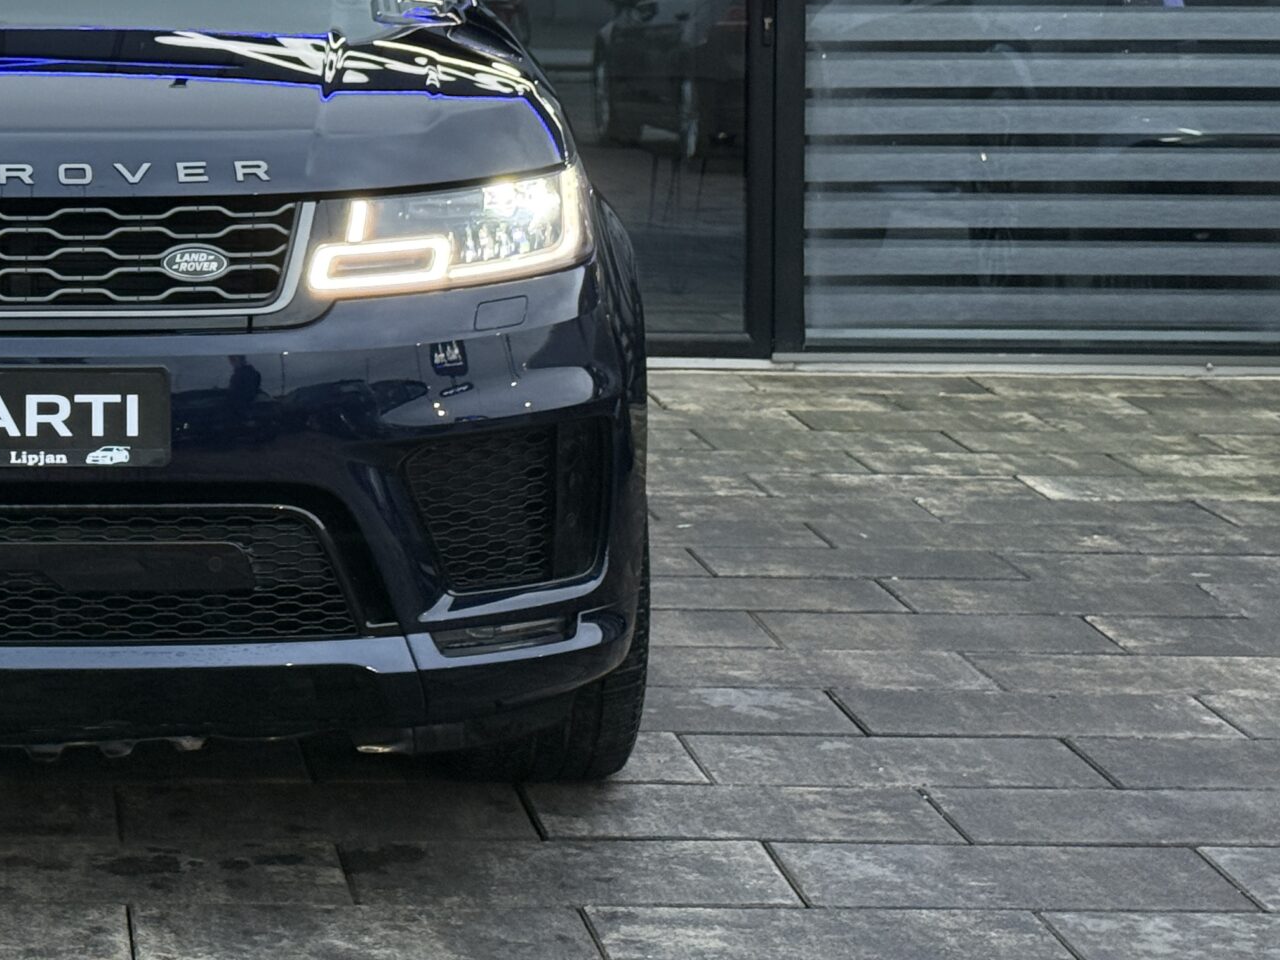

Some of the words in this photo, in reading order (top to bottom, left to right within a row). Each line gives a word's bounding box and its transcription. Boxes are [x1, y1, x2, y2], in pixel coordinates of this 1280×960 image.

[175, 252, 208, 262] LAND
[178, 261, 219, 272] ROVER
[10, 451, 68, 466] Lipjan
